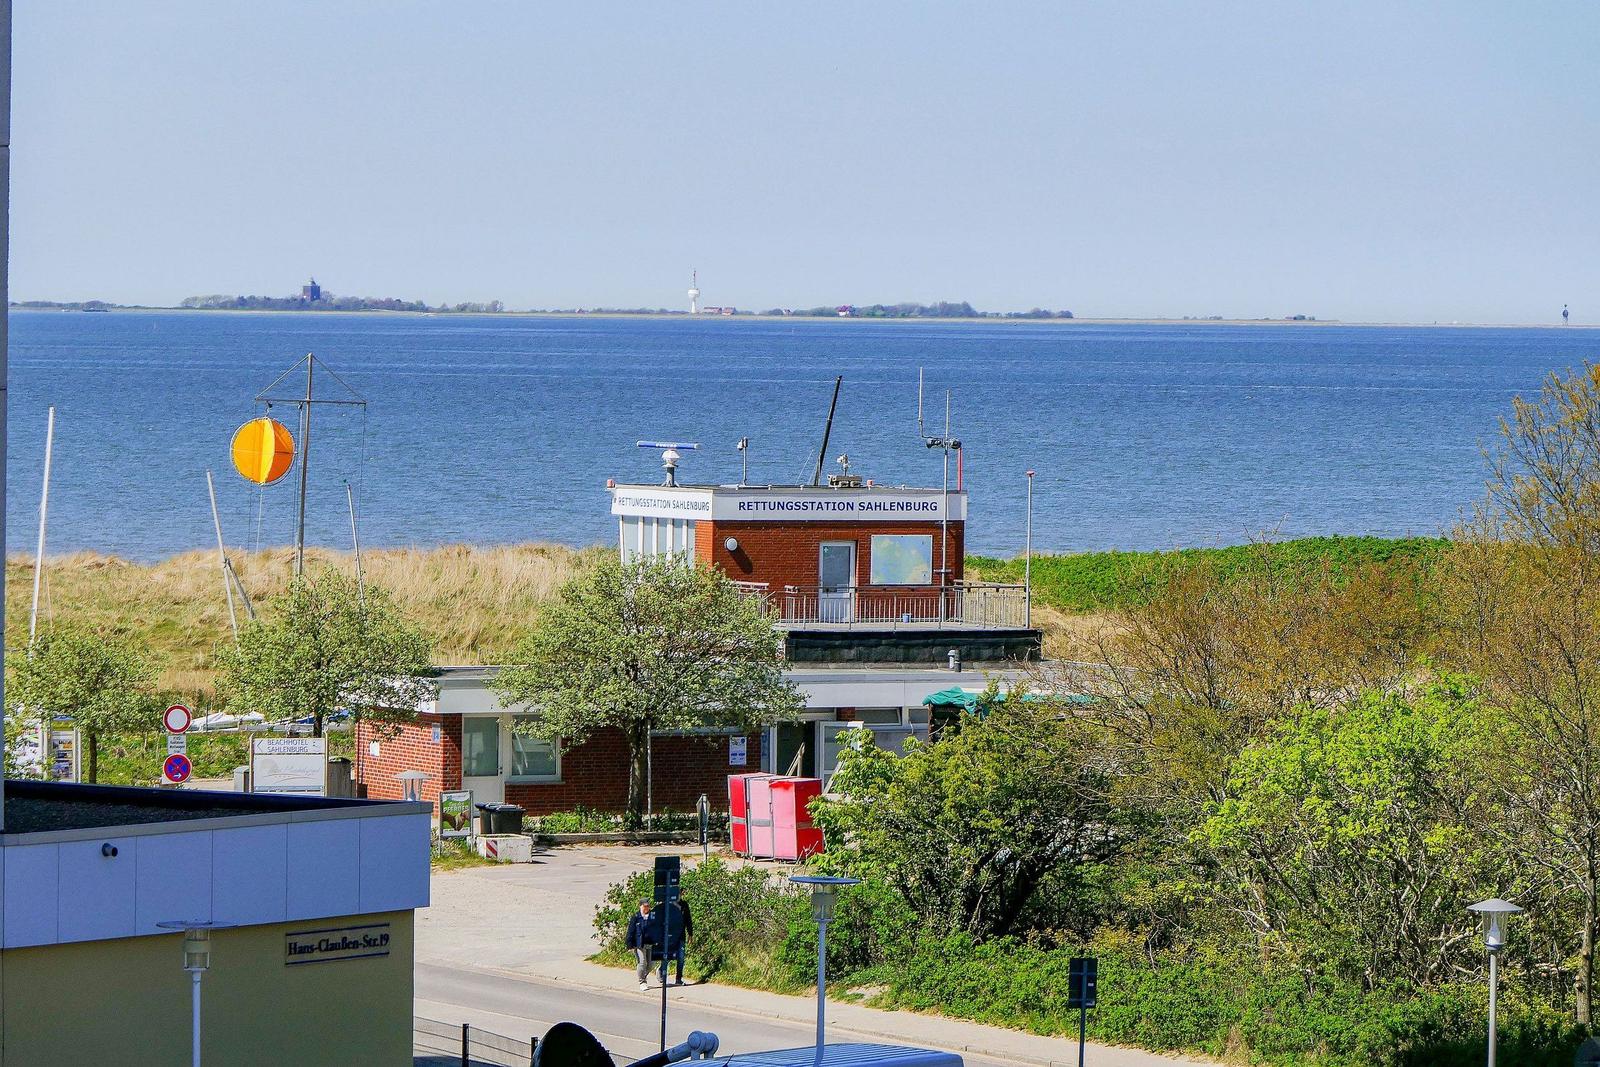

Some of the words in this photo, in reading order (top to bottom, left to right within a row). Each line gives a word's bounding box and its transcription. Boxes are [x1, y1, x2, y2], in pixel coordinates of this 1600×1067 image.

[618, 496, 671, 509] RETTUNGSSTATION
[672, 499, 710, 512] SAHLENBURG
[738, 501, 855, 512] RETTUNGSSTATION
[858, 501, 938, 512] SAHLENBURG
